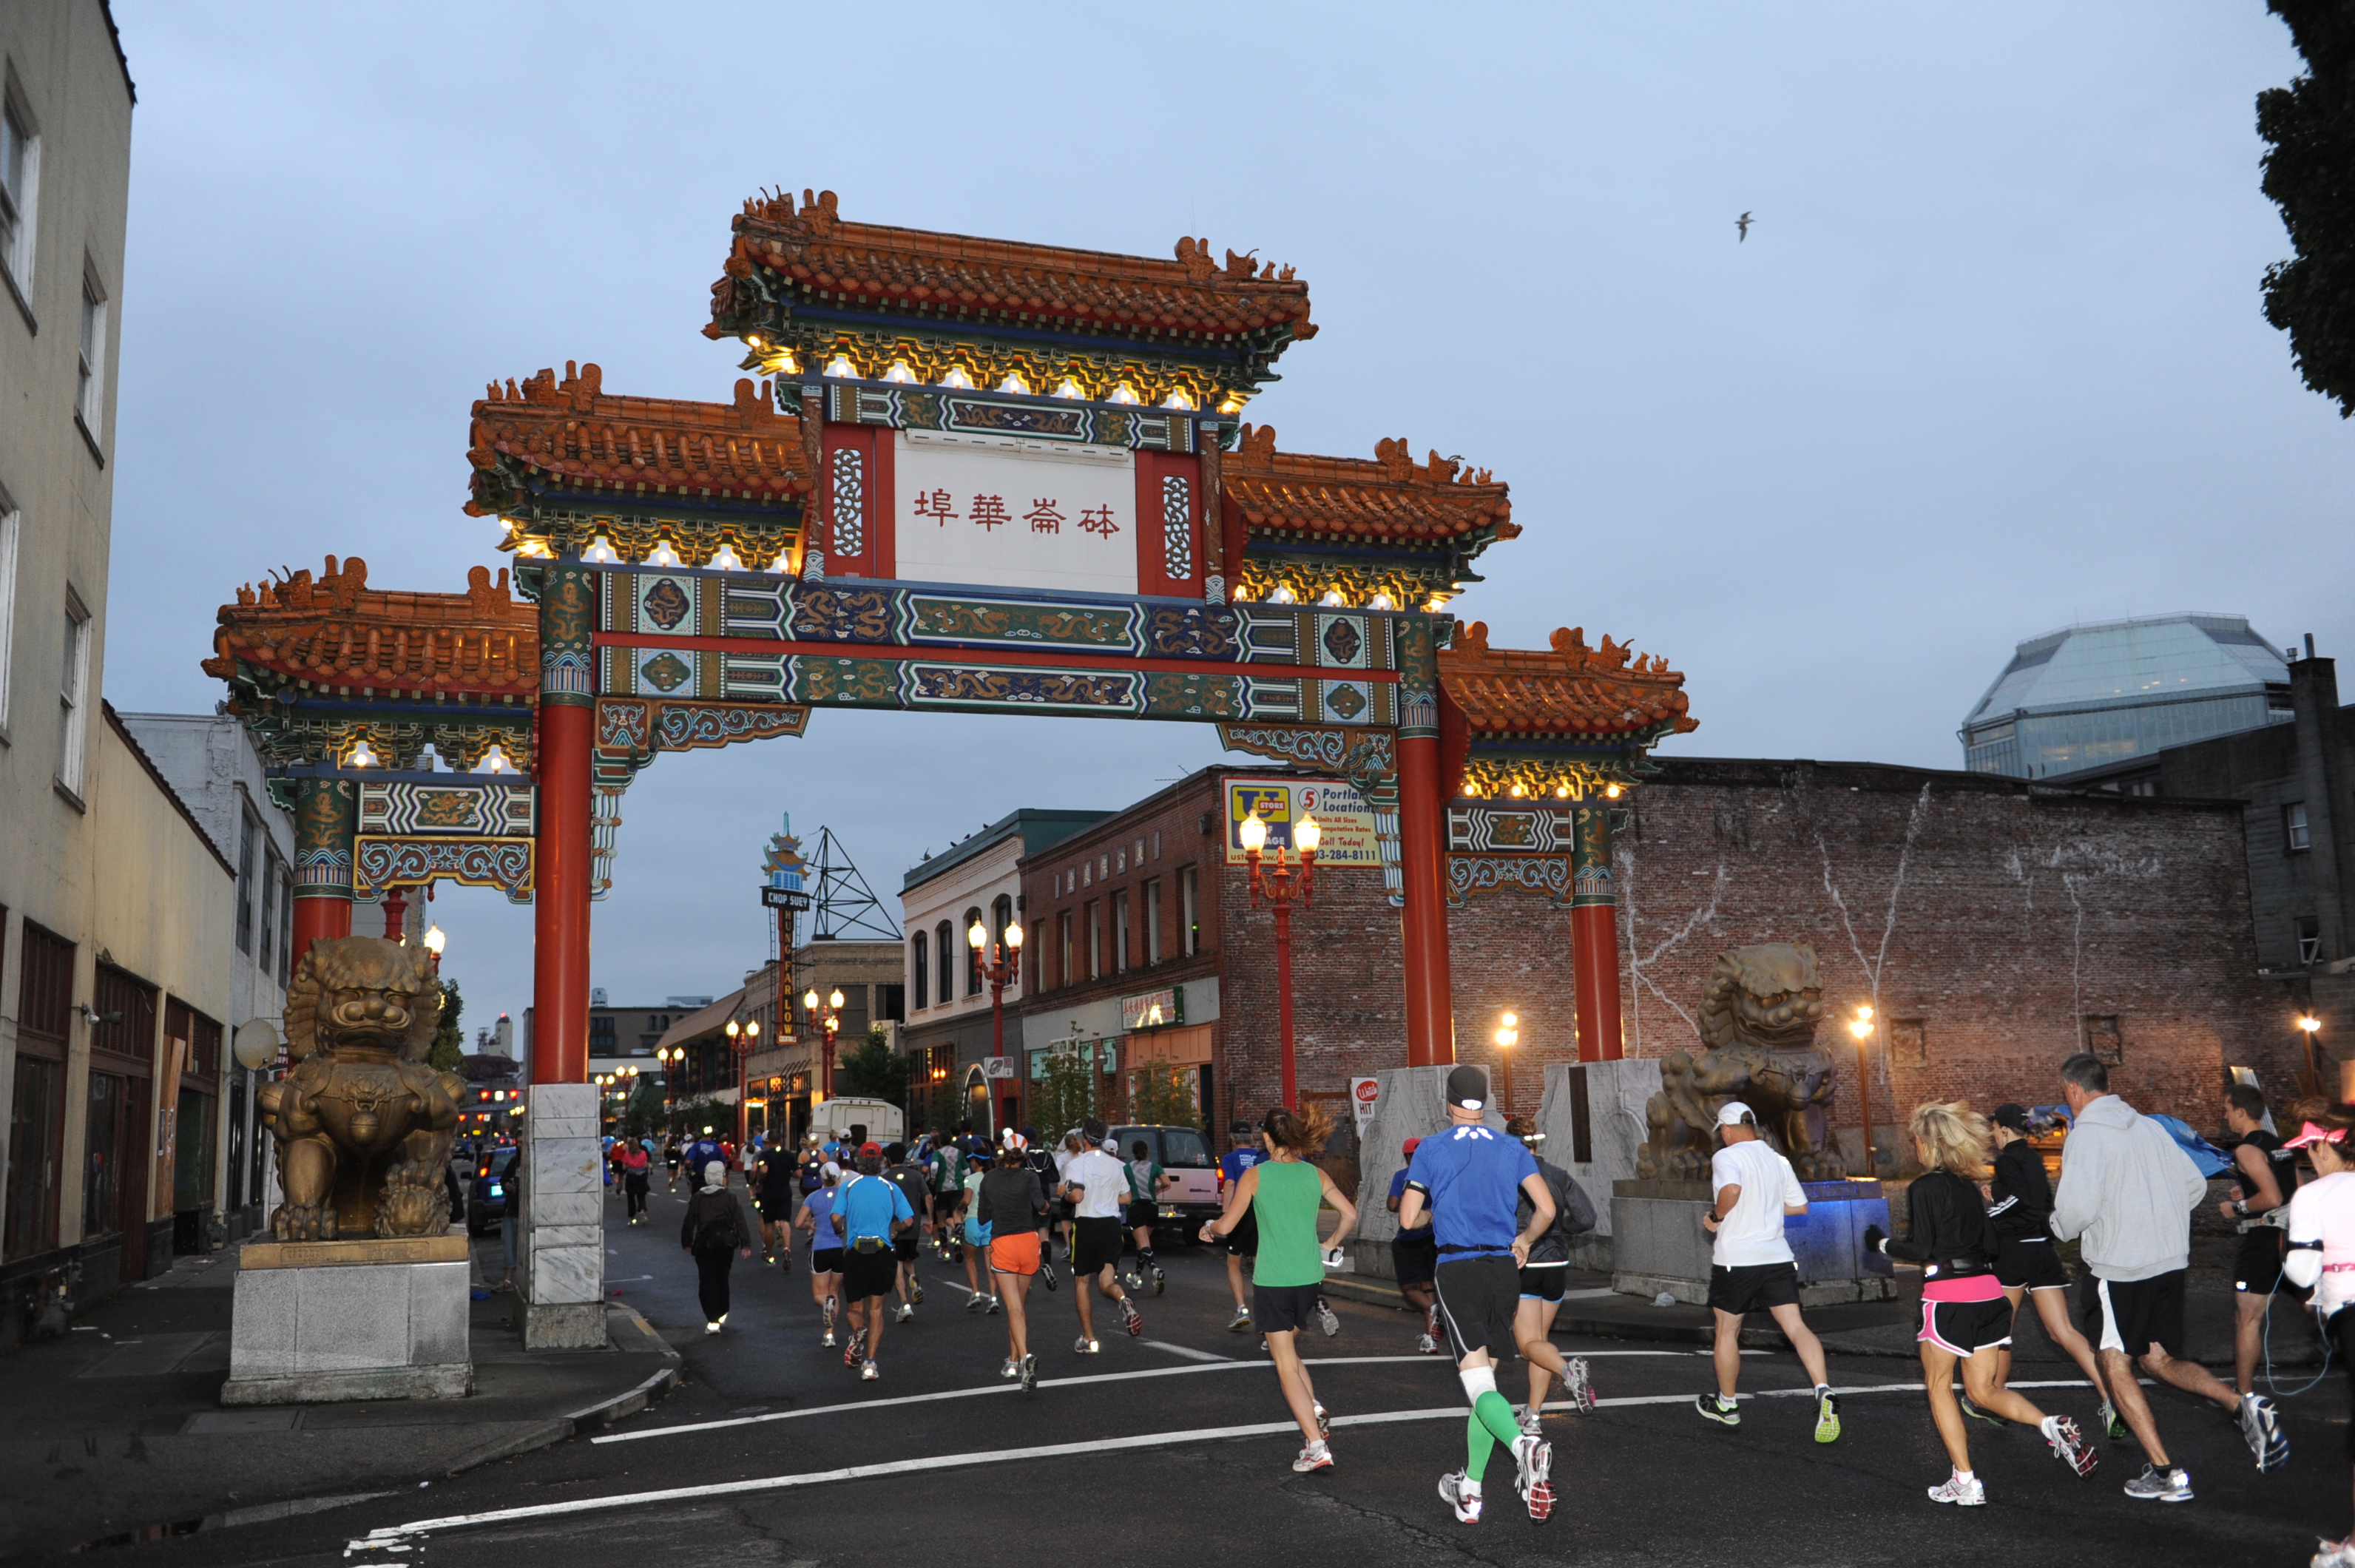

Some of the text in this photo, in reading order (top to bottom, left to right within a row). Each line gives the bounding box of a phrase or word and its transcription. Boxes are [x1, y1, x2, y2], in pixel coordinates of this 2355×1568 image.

[1303, 791, 1315, 808] 5
[1322, 788, 1364, 800] Portlan
[1323, 801, 1371, 813] Location
[1338, 837, 1365, 848] Today!
[1315, 848, 1376, 861] 03-284-8111
[768, 892, 808, 908] CHOP SUEY
[784, 910, 793, 1035] HUNG FAR LOW
[1359, 1103, 1372, 1115] HIT
